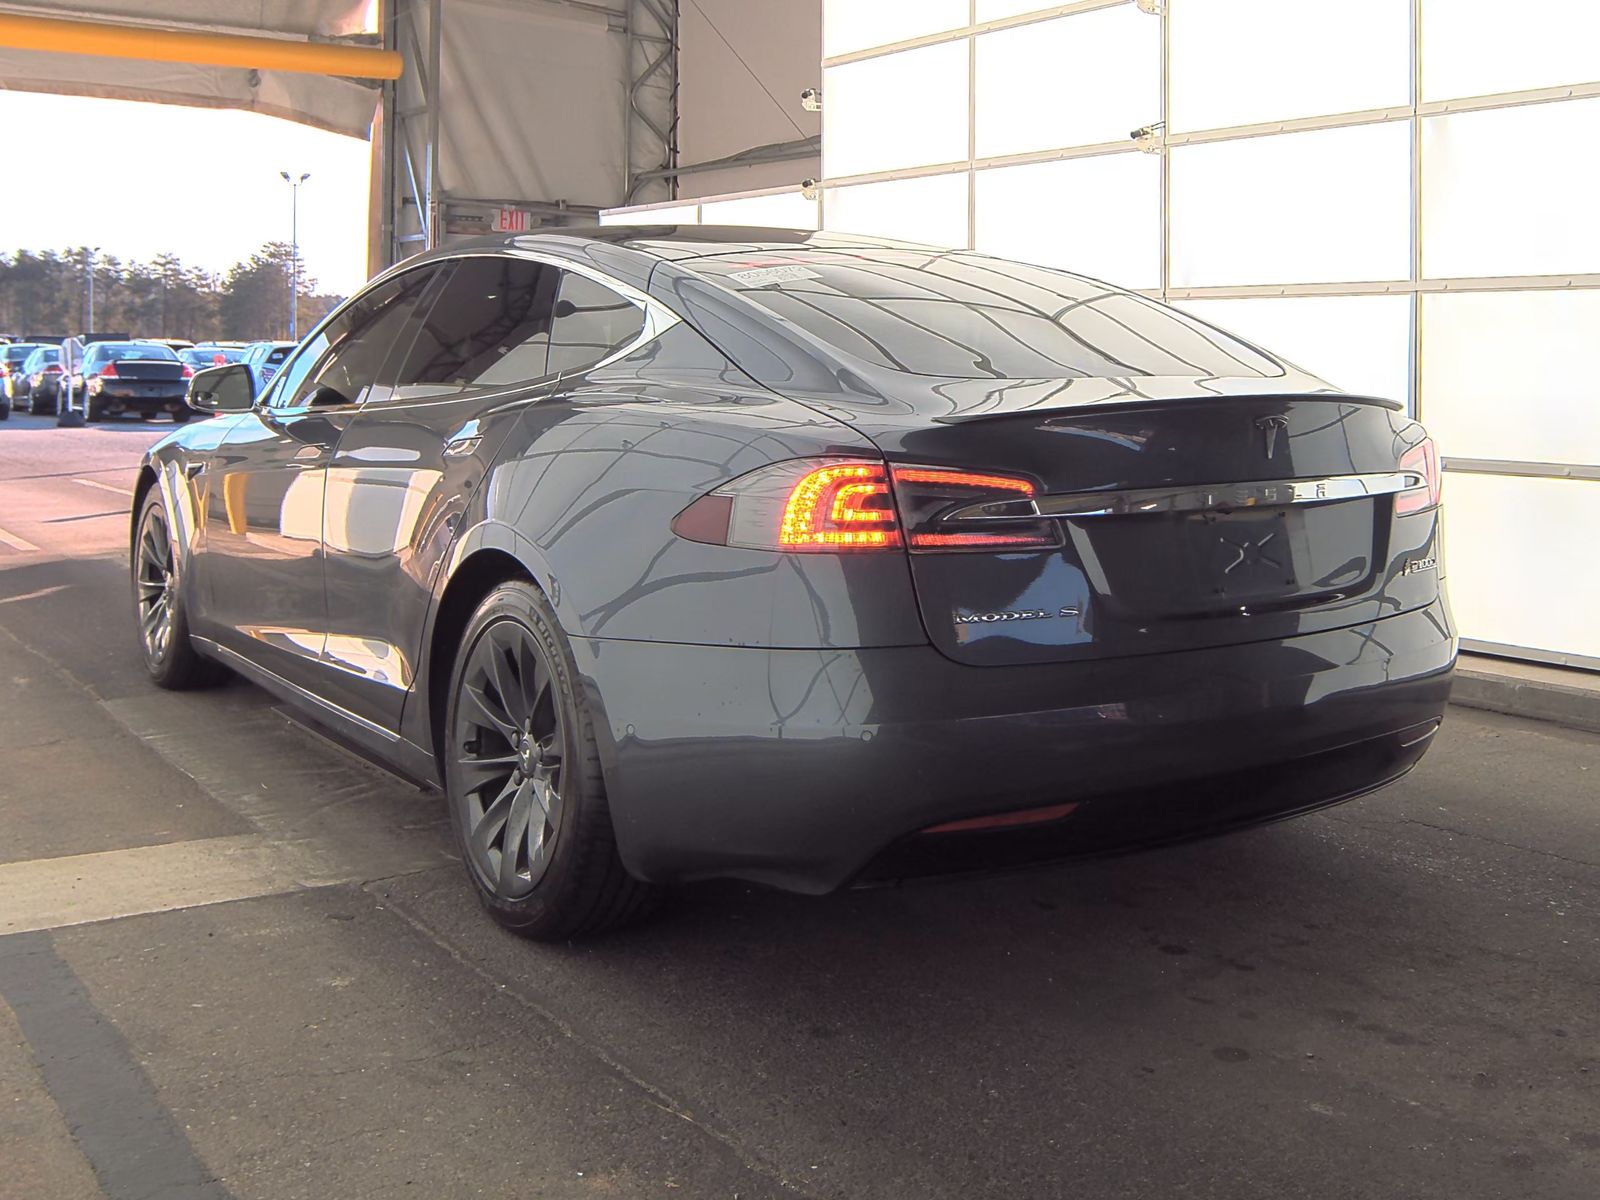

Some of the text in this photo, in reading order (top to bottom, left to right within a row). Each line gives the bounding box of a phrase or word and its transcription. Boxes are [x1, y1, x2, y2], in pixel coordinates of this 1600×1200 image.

[499, 208, 525, 231] EXIT
[952, 606, 1079, 624] MODEL S
